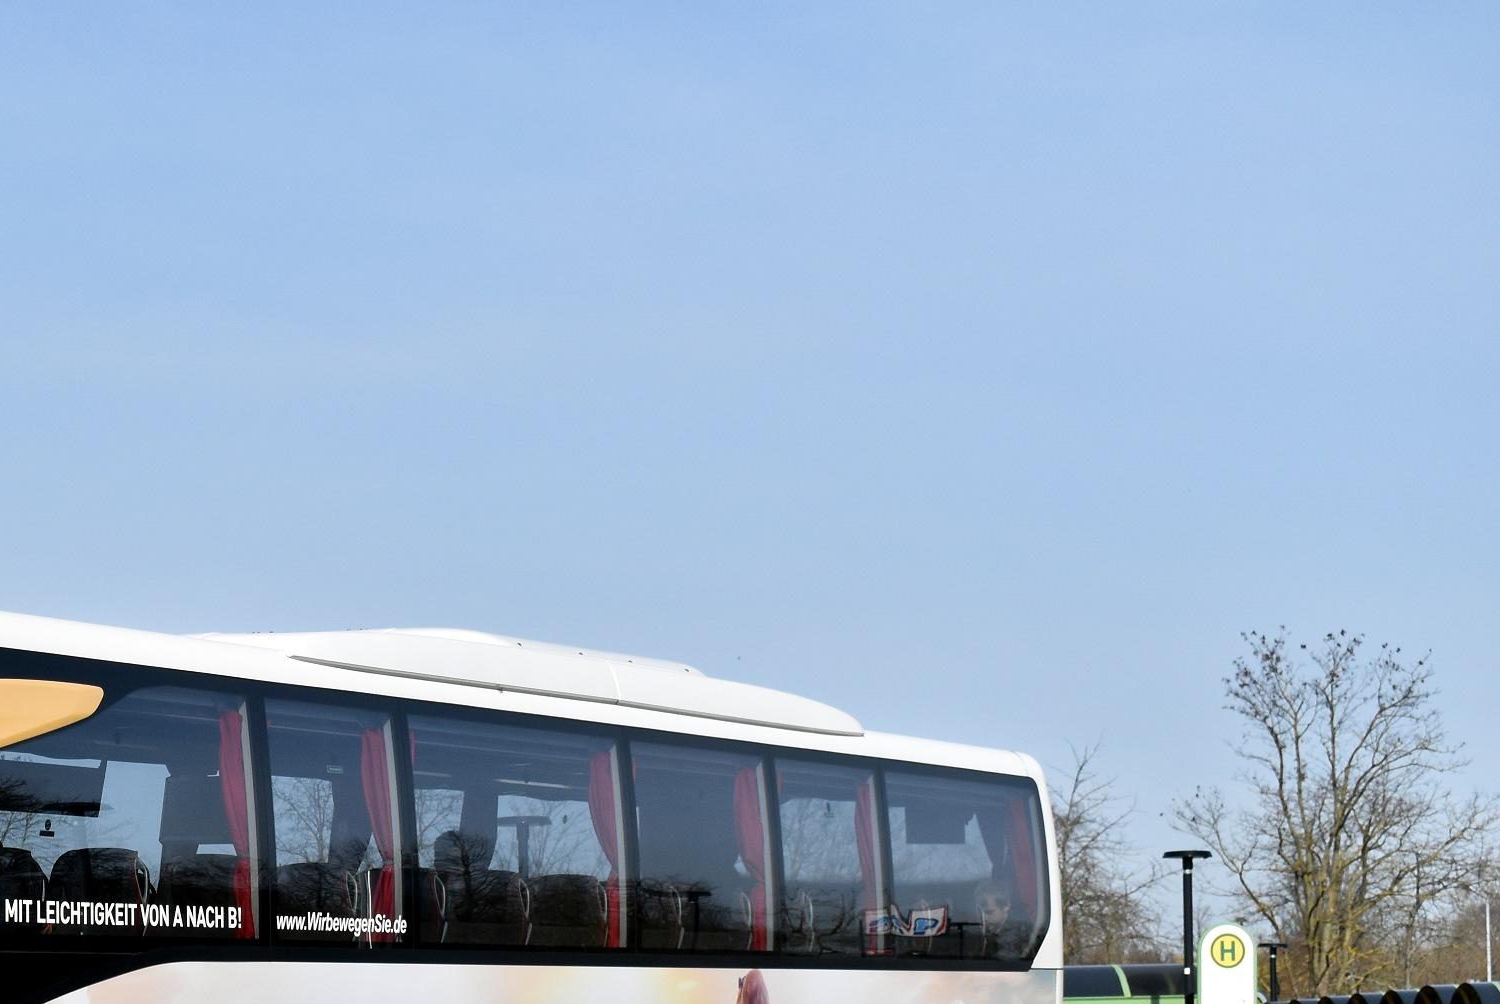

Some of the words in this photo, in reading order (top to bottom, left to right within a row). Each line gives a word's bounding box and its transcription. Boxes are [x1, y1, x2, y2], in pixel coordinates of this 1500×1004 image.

[4, 898, 32, 923] MIT
[36, 900, 138, 926] LEICHTIGKEIT
[140, 903, 170, 927] VON
[172, 905, 184, 928] A
[186, 905, 225, 929] NACH
[227, 906, 243, 929] B!
[276, 911, 407, 937] www.WirbewegenSie.de
[1220, 940, 1236, 962] H
